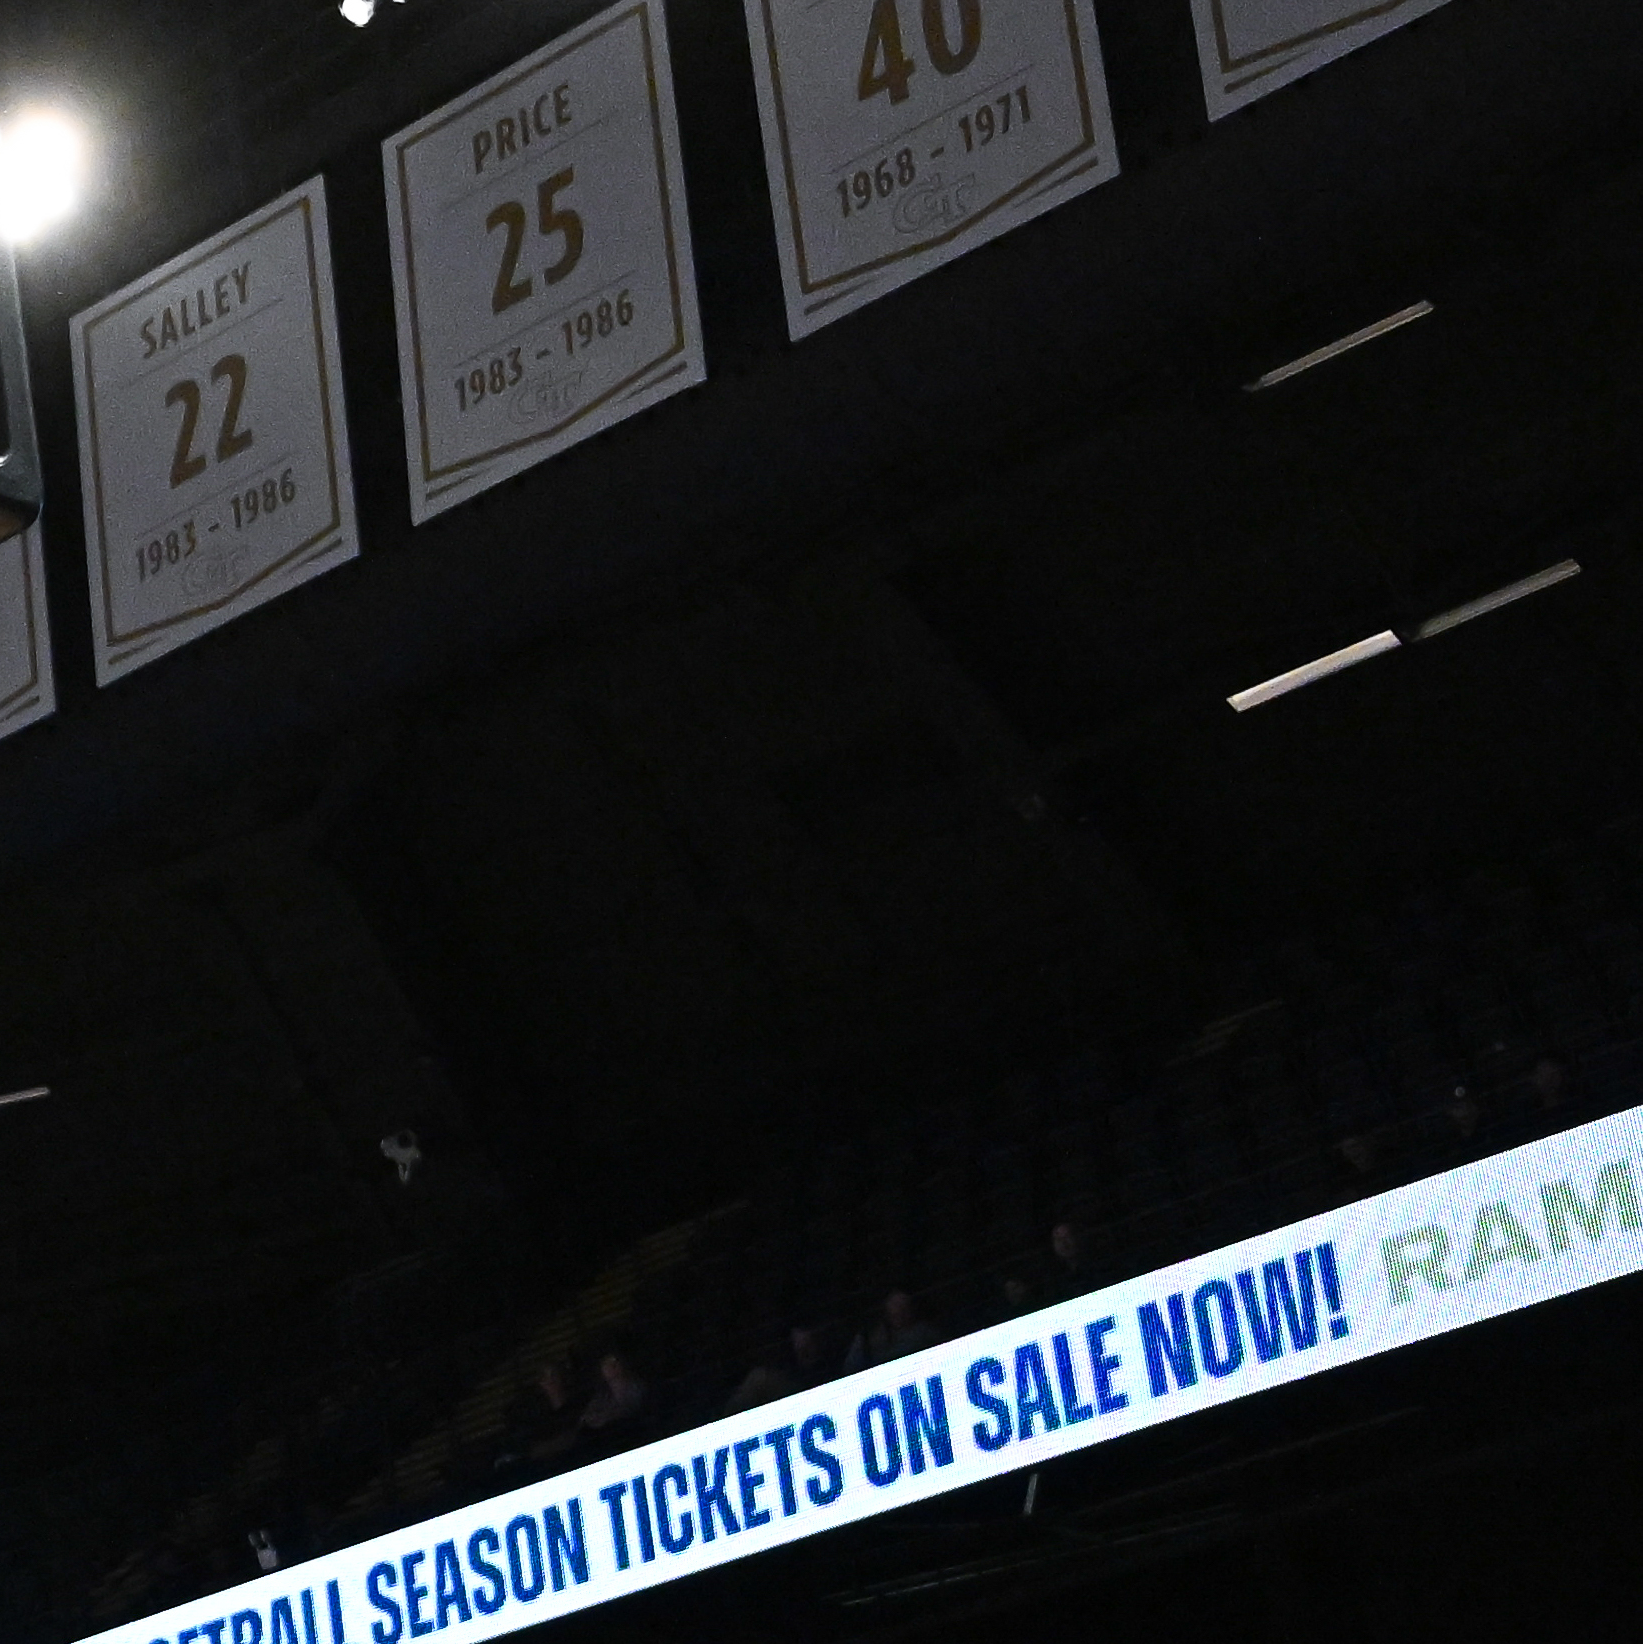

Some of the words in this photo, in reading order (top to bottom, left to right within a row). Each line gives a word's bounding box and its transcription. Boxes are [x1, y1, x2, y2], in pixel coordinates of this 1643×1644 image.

[856, 0, 984, 107] 40
[472, 84, 575, 175] PRICE
[833, 147, 916, 219] 1968
[956, 84, 1034, 152] 1971
[485, 163, 586, 317] 25
[139, 260, 254, 360] SALLEY
[454, 345, 524, 413] 1983
[561, 288, 635, 355] 1986
[164, 353, 254, 490] 22
[136, 518, 198, 583] 1983
[230, 467, 297, 531] 1986
[598, 1413, 845, 1571] TICKETS
[855, 1373, 954, 1489] ON
[964, 1315, 1128, 1455] SALE
[1134, 1241, 1351, 1399] NOW!
